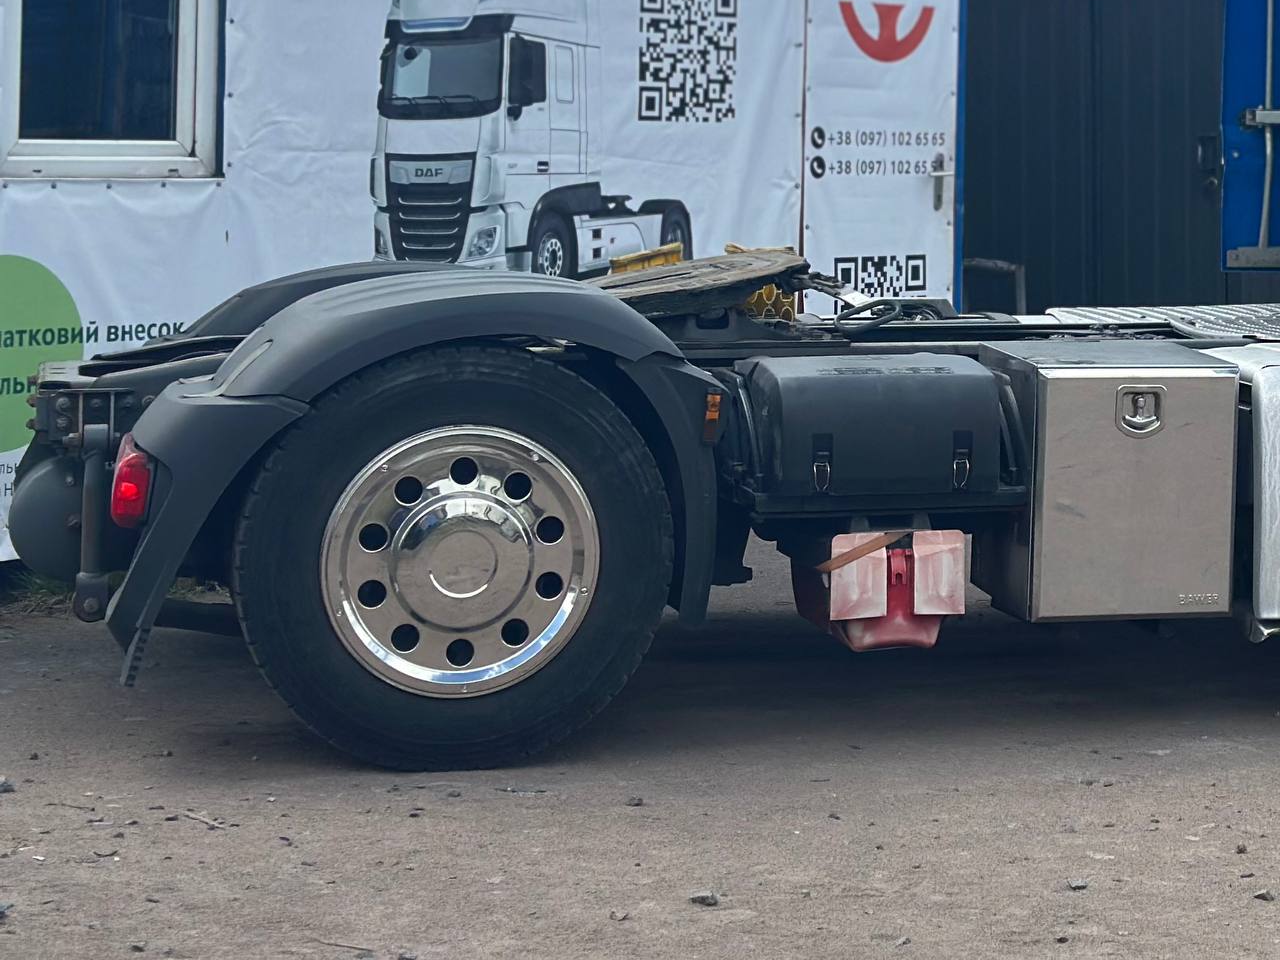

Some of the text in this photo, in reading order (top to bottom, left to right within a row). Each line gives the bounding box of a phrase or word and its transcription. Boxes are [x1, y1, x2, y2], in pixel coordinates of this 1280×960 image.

[828, 131, 945, 147] +38 (097) 102 65 65
[415, 168, 443, 178] DAF
[829, 160, 851, 175] +38
[856, 160, 887, 176] (097)
[892, 160, 911, 174] 102
[914, 160, 927, 174] 65
[0, 321, 184, 348] атковий внесок
